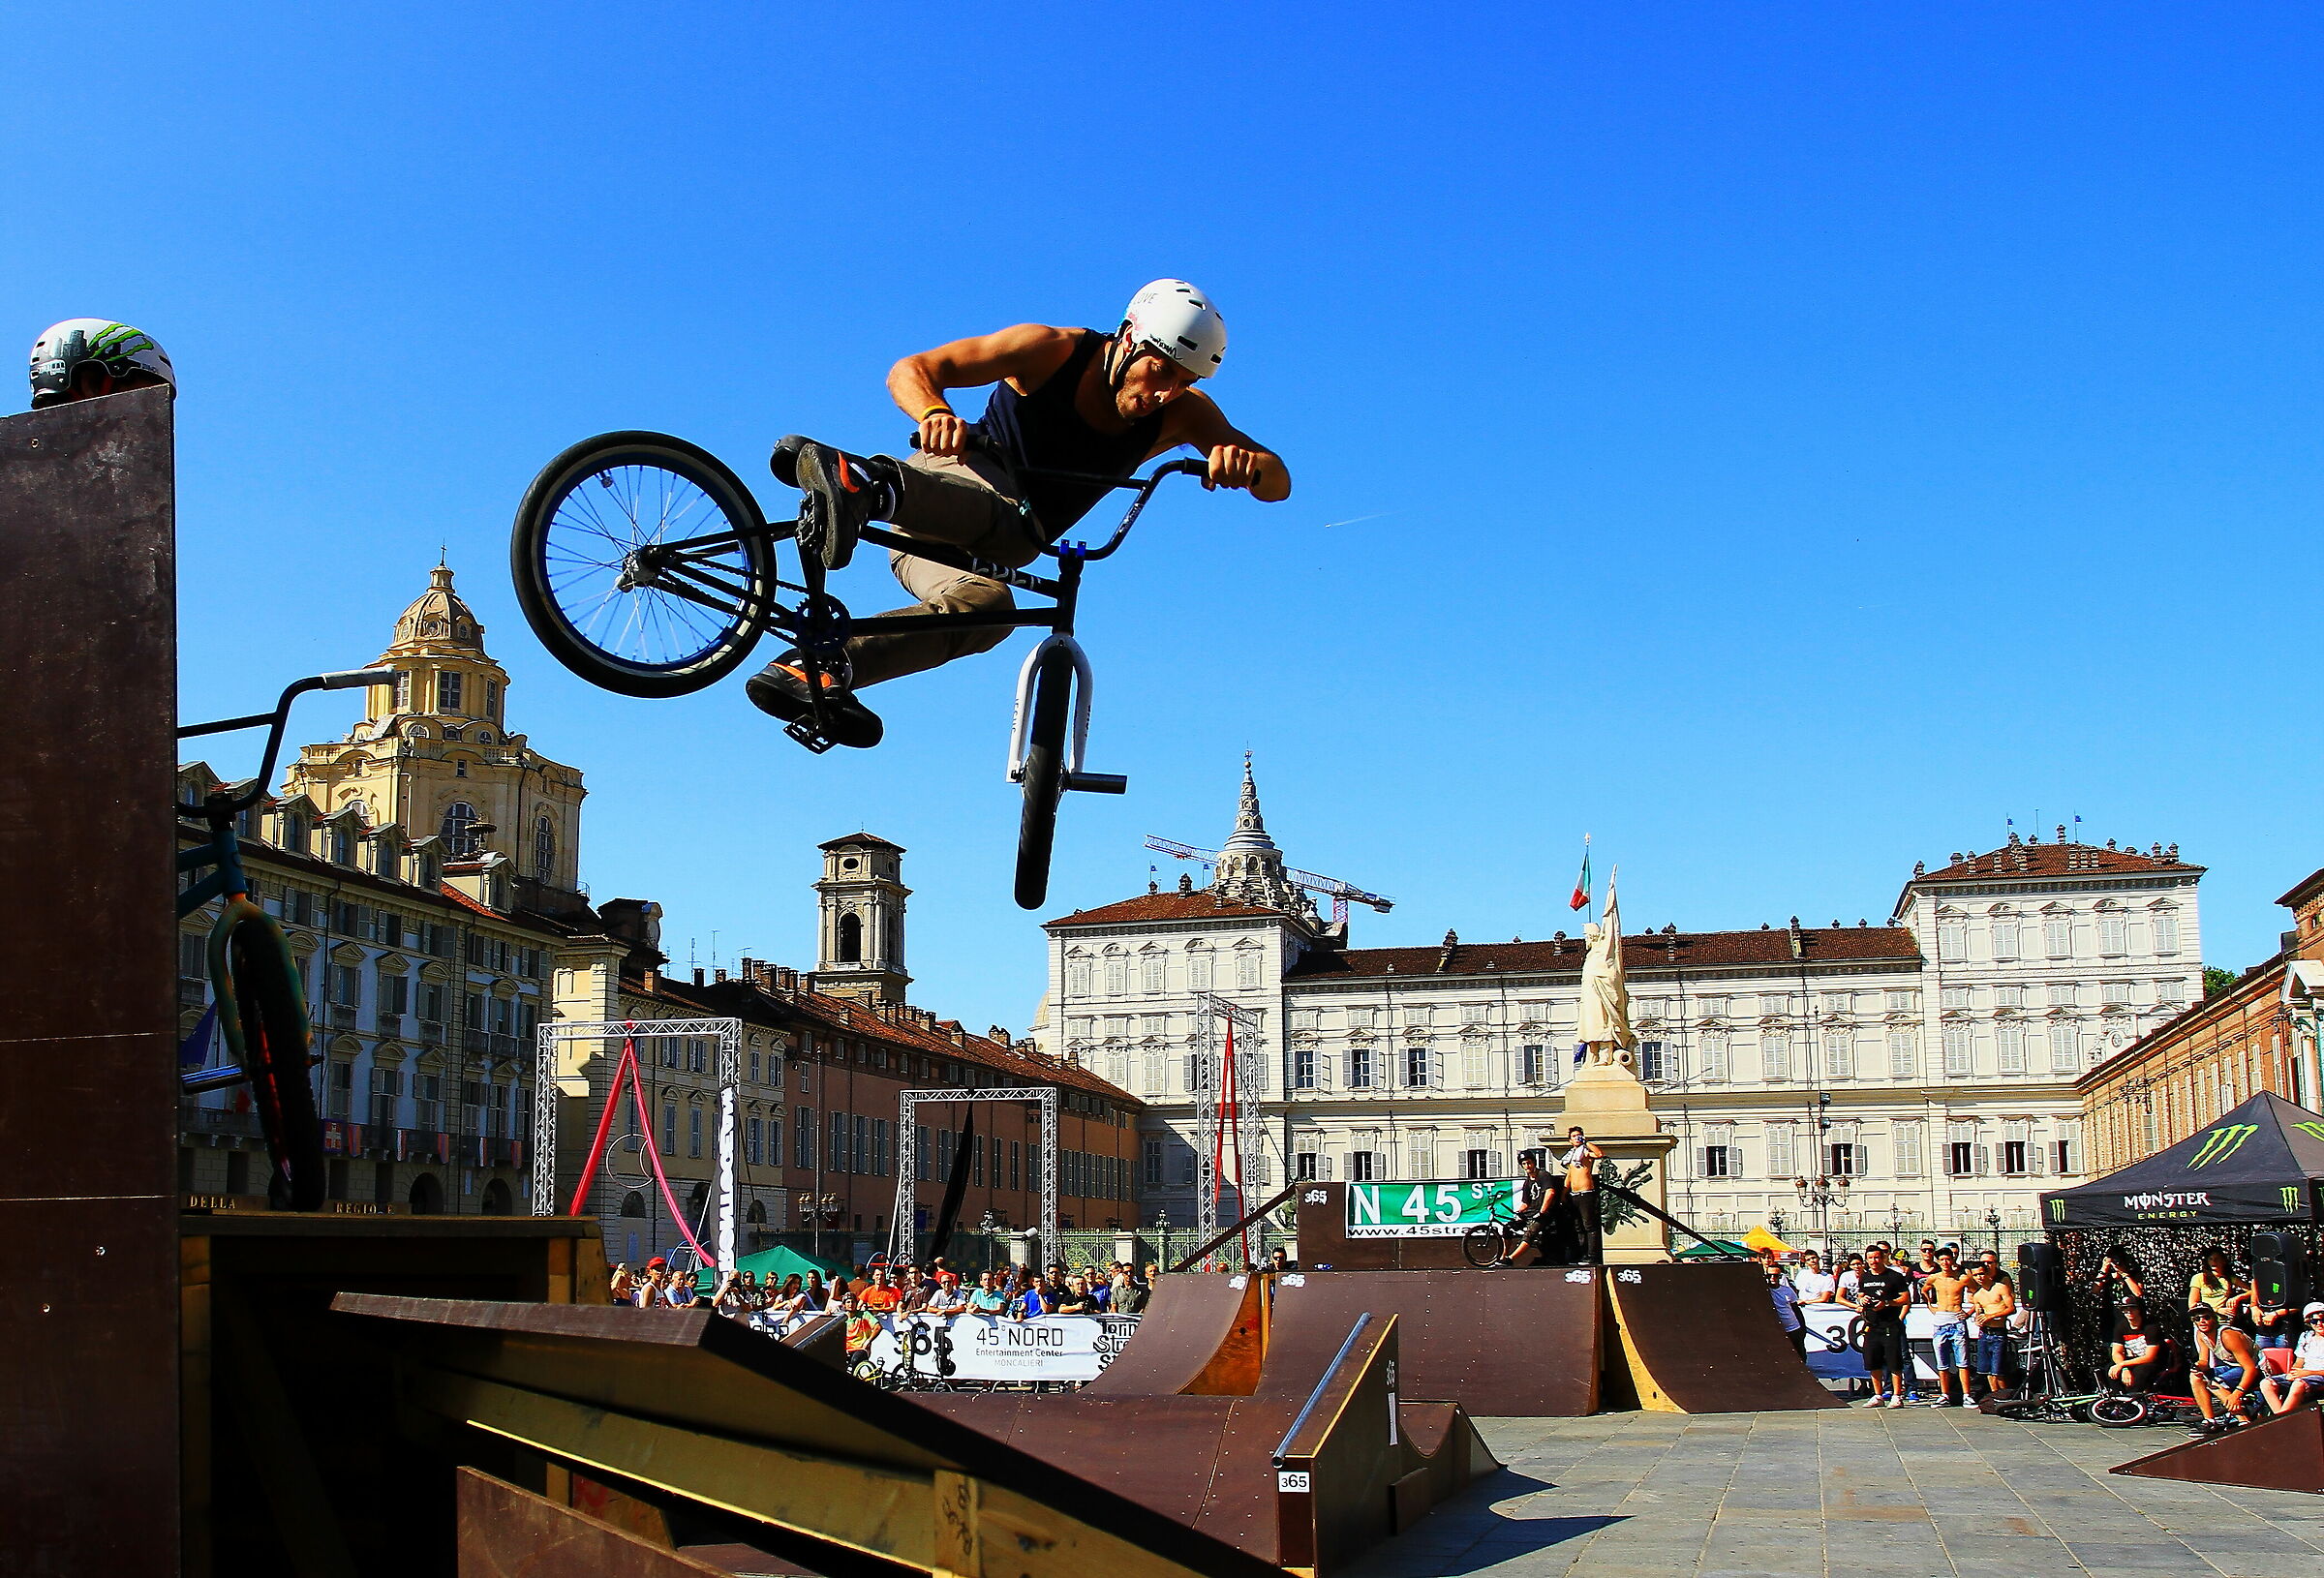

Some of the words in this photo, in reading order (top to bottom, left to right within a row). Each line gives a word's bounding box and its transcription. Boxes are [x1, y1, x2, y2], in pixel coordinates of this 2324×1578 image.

[189, 1195, 236, 1209] DELLA
[1304, 1189, 1328, 1205] 365
[1353, 1185, 1381, 1225] N
[1401, 1184, 1463, 1224] 45
[1471, 1182, 1496, 1199] ST
[2124, 1191, 2213, 1210] MONSTER
[336, 1202, 394, 1215] REGIOE
[2137, 1210, 2197, 1220] ENERGY
[1564, 1269, 1591, 1285] 365
[1617, 1269, 1642, 1284] 365
[1096, 1318, 1139, 1337] Torin
[1825, 1315, 1867, 1353] 36
[975, 1348, 1033, 1357] Entertainment
[1035, 1349, 1064, 1357] Center
[994, 1358, 1044, 1367] MONCALIERI
[1281, 1473, 1307, 1488] 365
